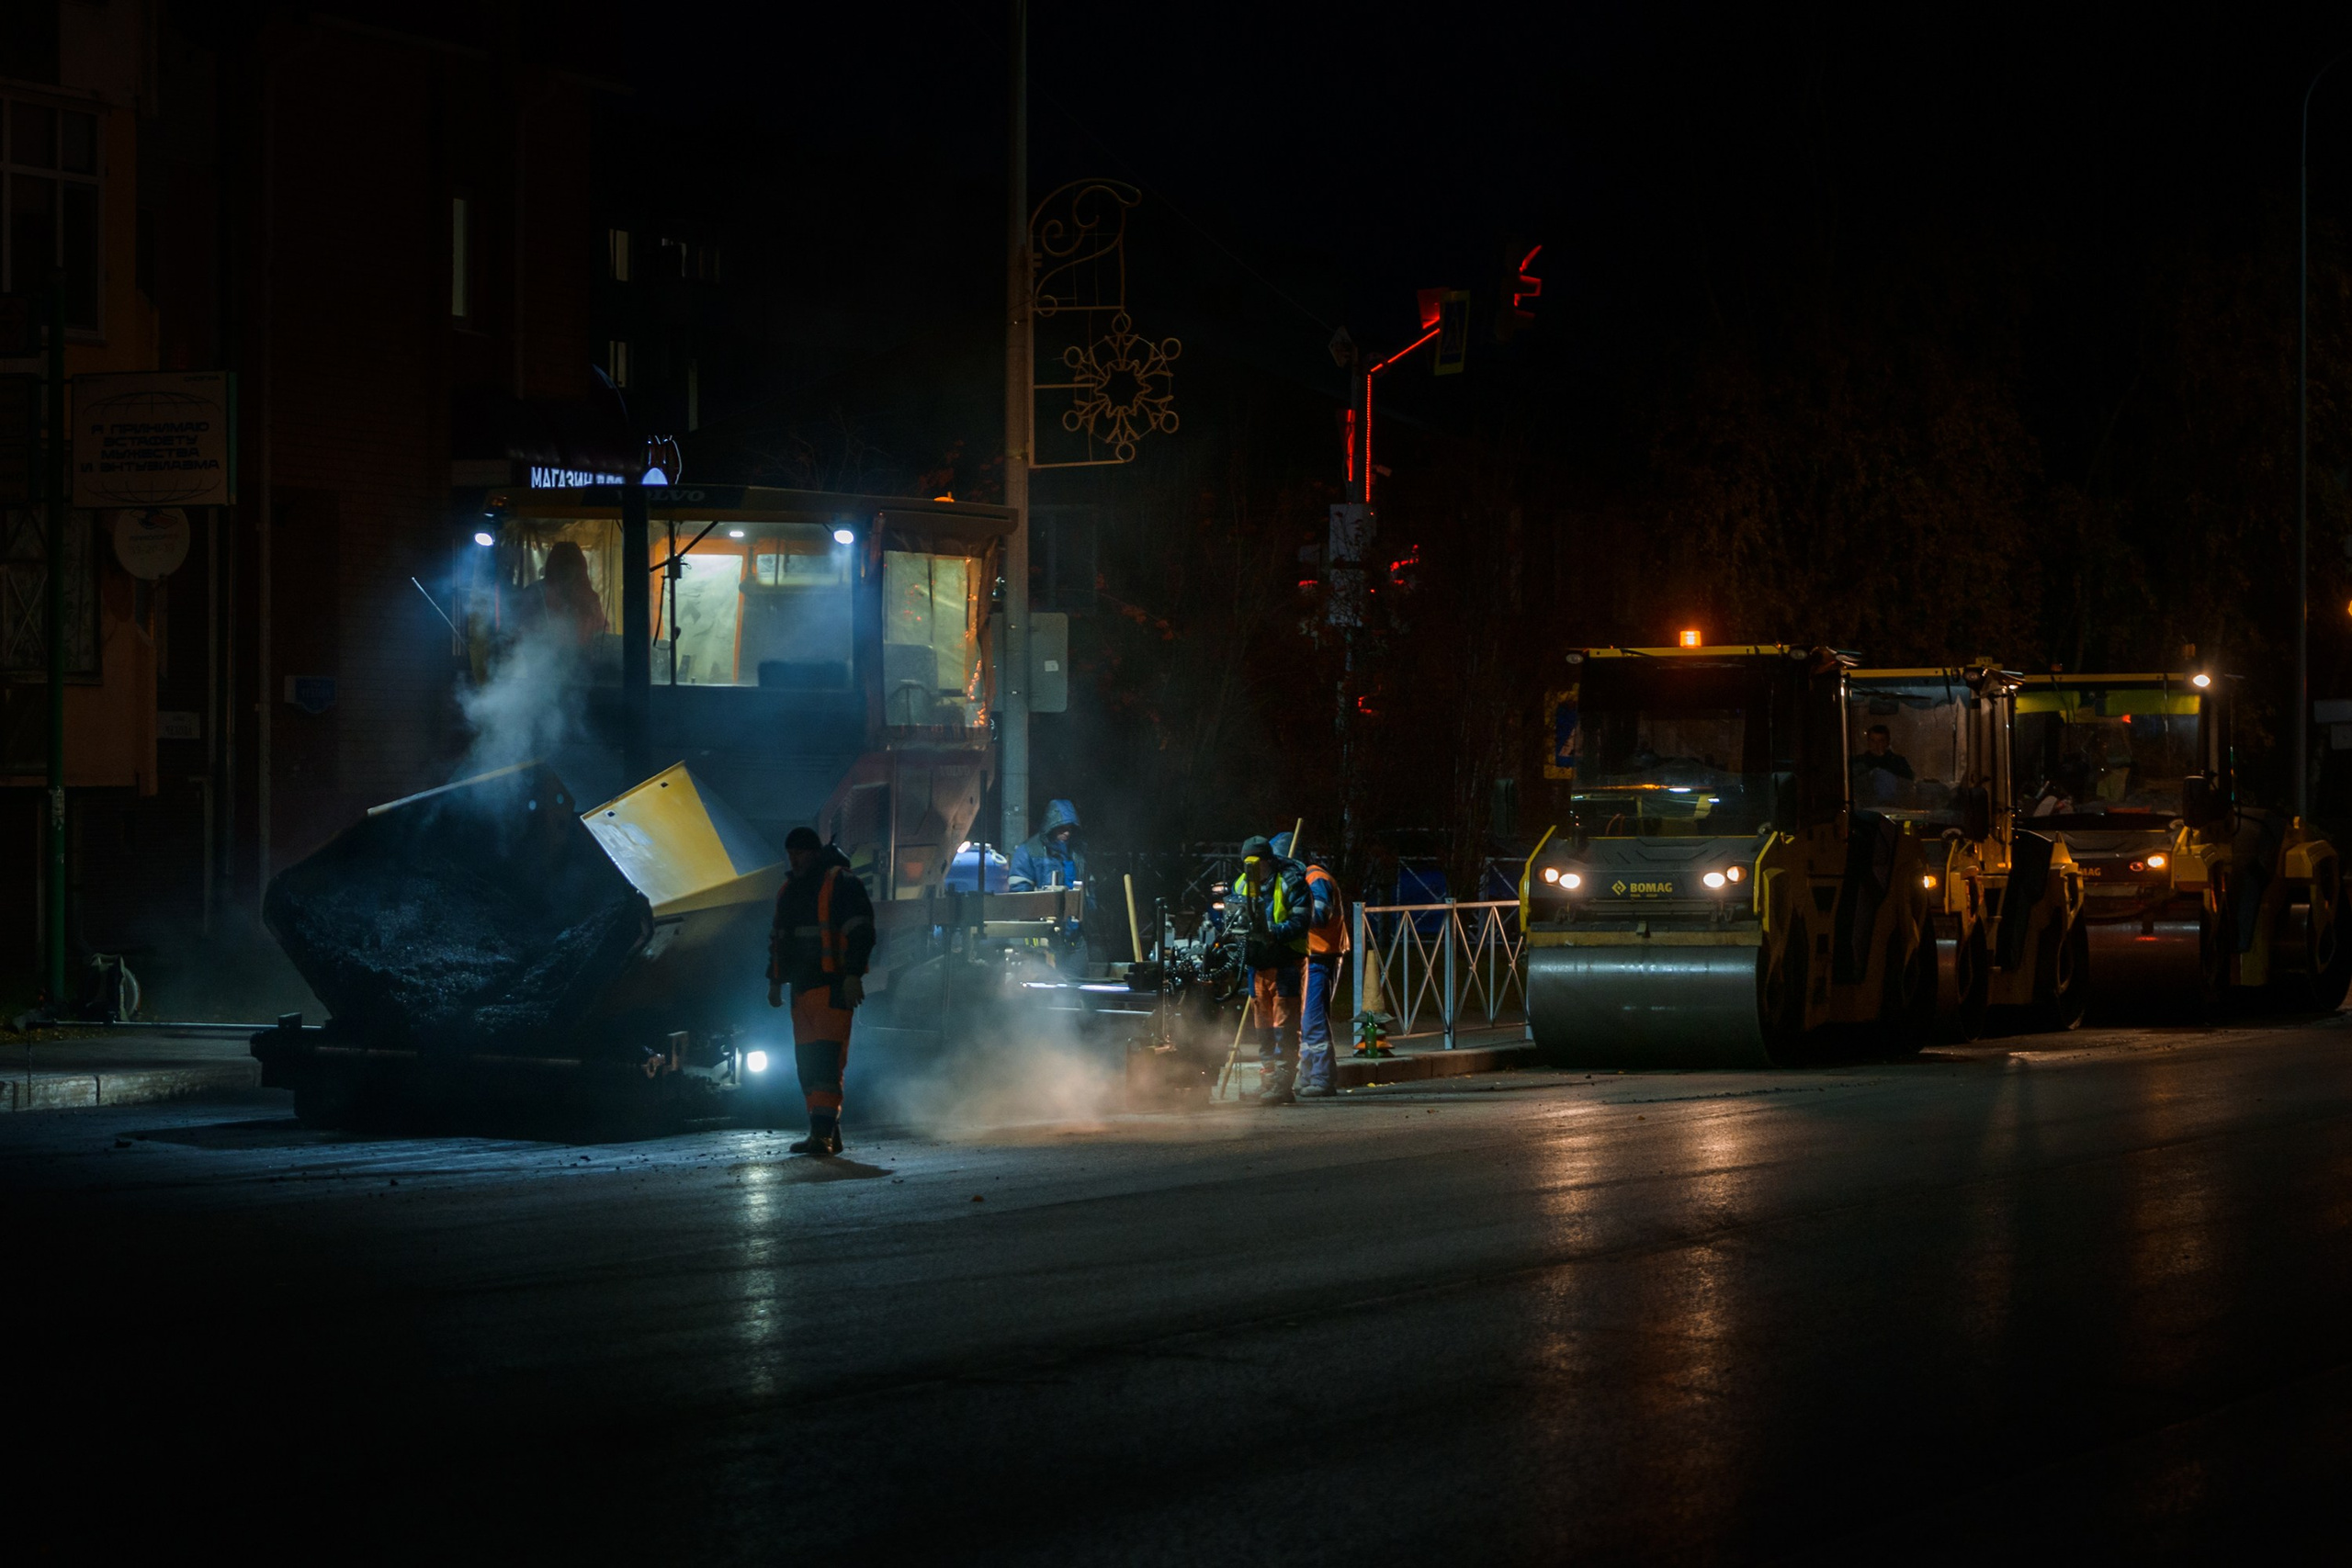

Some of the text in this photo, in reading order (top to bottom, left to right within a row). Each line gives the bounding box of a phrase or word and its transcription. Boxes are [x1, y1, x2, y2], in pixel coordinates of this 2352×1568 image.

[91, 422, 209, 434] Я ПРИНИМАЮ
[103, 434, 198, 447] ЭСТАФЕТУ
[100, 447, 200, 459] МУЖЕСТВА
[80, 459, 220, 473] И ЭНТУЗИАЗМА
[530, 467, 594, 489] МАГАЗИН
[2079, 867, 2101, 876] MAG
[1630, 882, 1673, 893] BOMAG
